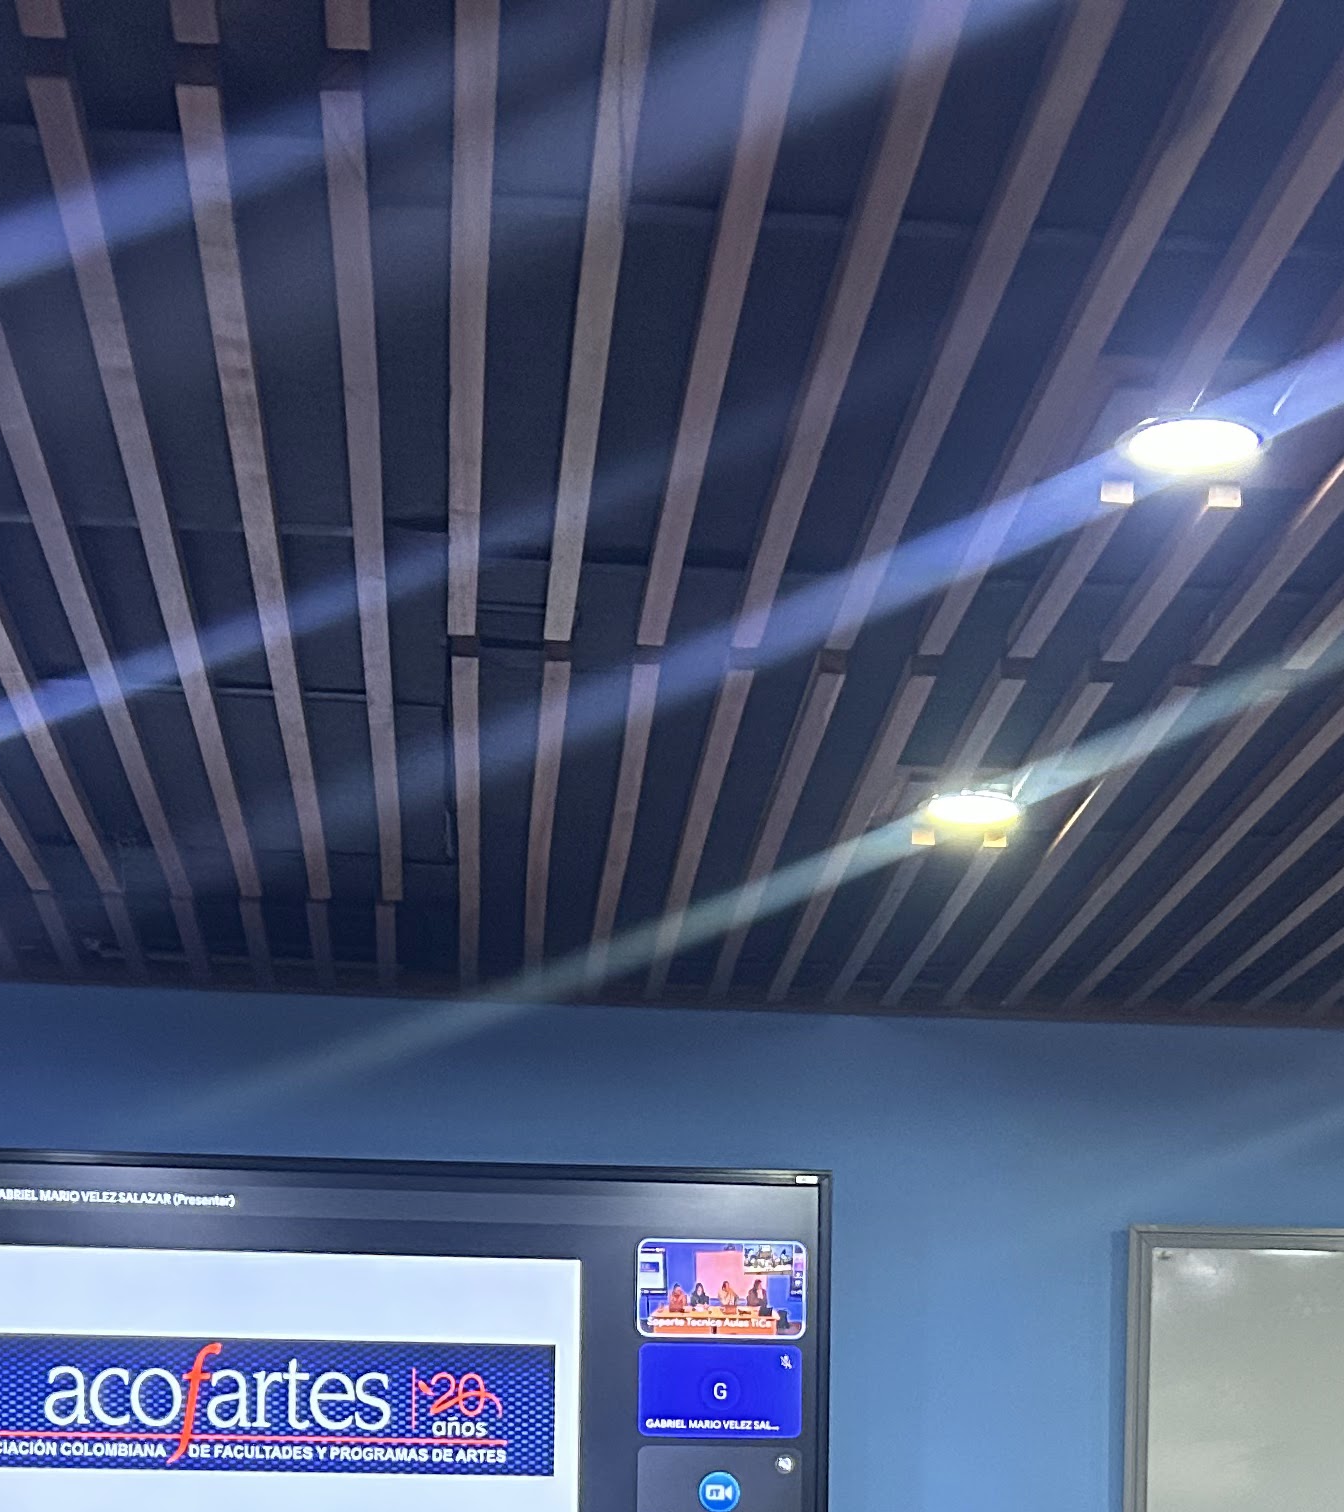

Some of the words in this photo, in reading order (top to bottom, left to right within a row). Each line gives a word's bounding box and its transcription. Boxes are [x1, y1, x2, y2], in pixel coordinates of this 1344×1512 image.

[39, 1189, 80, 1202] MARIO
[81, 1190, 118, 1203] VELEZ
[119, 1191, 172, 1204] SALAZAR
[713, 1382, 728, 1400] G
[44, 1342, 392, 1464] acofartes
[432, 1416, 488, 1438] años
[645, 1418, 687, 1430] GABRIEL
[688, 1419, 722, 1430] MARIO
[723, 1420, 752, 1431] VELEZ
[60, 1442, 167, 1458] COLOMBIANA
[188, 1444, 210, 1458] DE
[213, 1444, 314, 1460] FACULTADES
[315, 1446, 328, 1460] Y
[329, 1446, 429, 1462] PROGRAMAS
[432, 1448, 455, 1462] DE
[455, 1449, 507, 1464] ARTES
